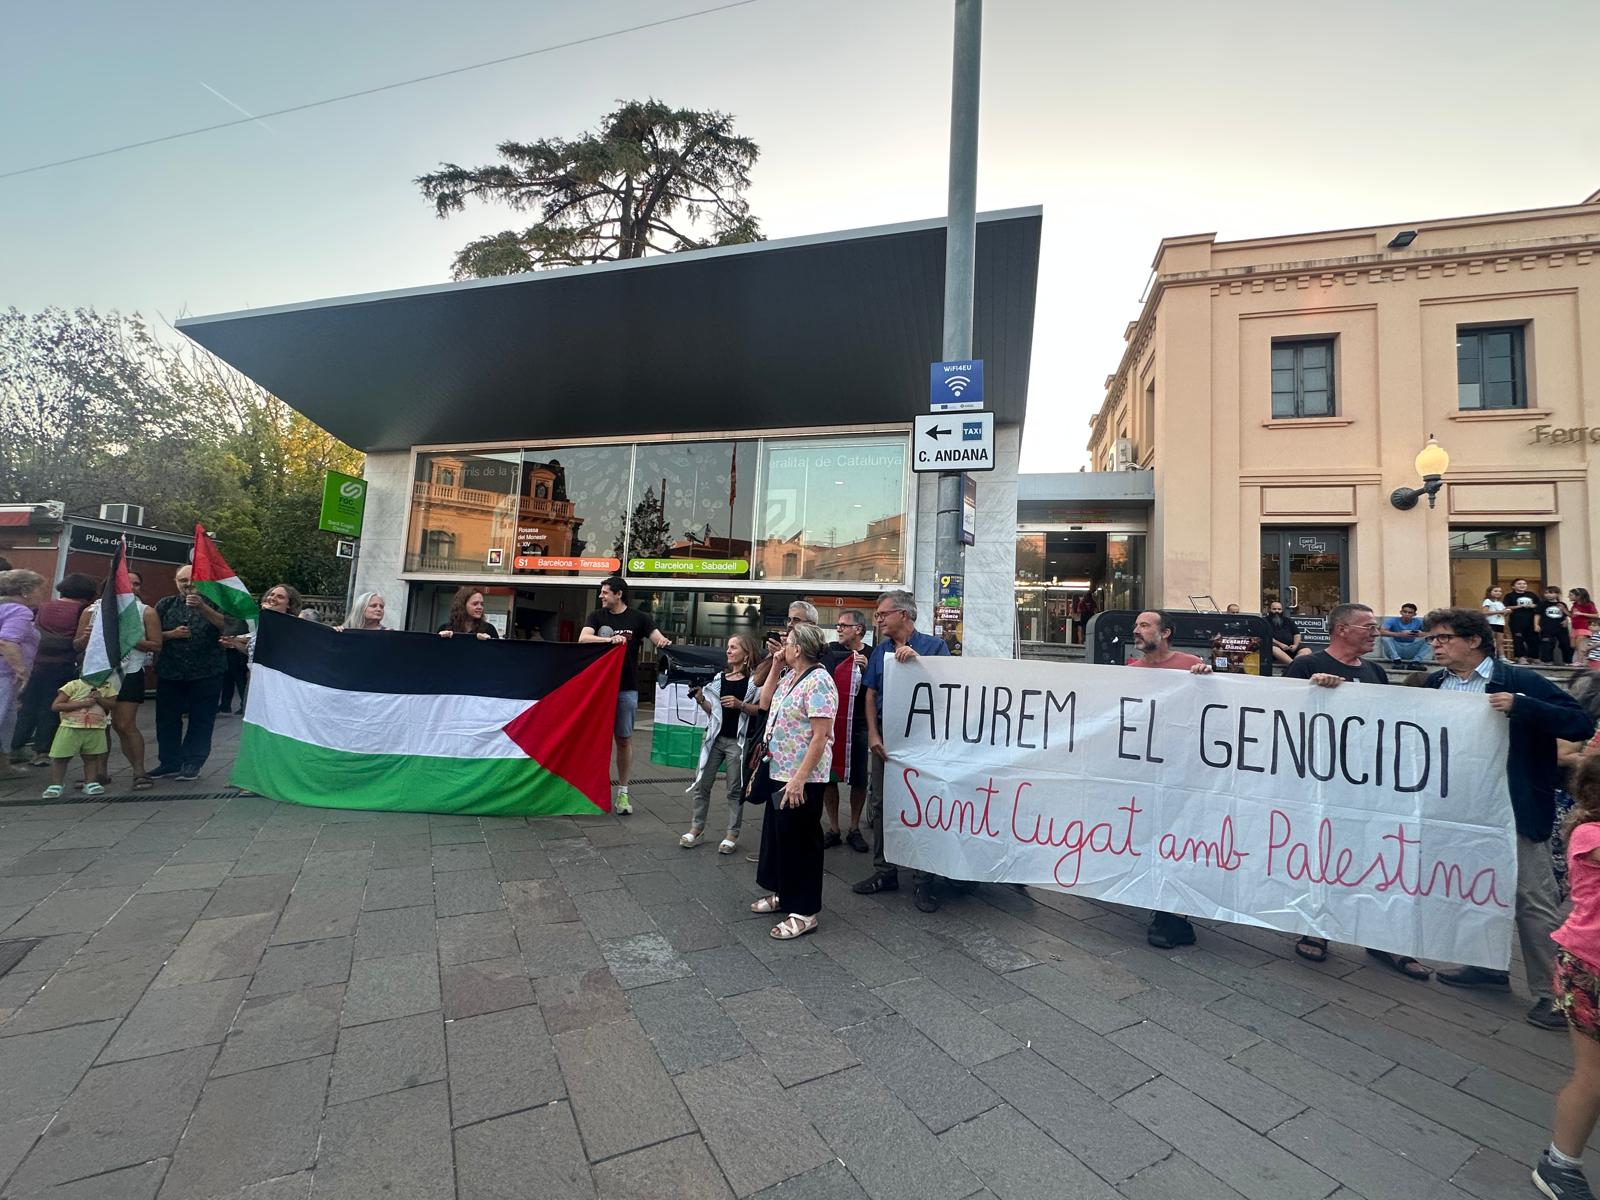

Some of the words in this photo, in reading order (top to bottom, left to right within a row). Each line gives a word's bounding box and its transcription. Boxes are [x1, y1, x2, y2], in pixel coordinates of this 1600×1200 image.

[963, 427, 982, 436] TAXI
[815, 456, 832, 467] de
[837, 454, 902, 468] Catalunya
[918, 450, 930, 463] C.
[934, 448, 989, 462] ANDANA
[85, 533, 110, 545] Plaça
[110, 538, 121, 546] de
[126, 540, 158, 552] 'Estació
[518, 558, 528, 567] S1
[538, 559, 573, 567] Barcelona
[580, 559, 610, 568] Terrassa
[633, 561, 645, 570] S2
[654, 561, 694, 570] Barcelona
[701, 561, 737, 570] Sabadell
[904, 682, 1077, 753] ATUREM
[1118, 697, 1164, 764] EL
[1199, 704, 1449, 799] GENOCIDI
[900, 767, 1000, 837] Sant
[1011, 782, 1143, 888] Cugat
[1158, 814, 1250, 871] amb
[1266, 809, 1510, 908] Palestina
